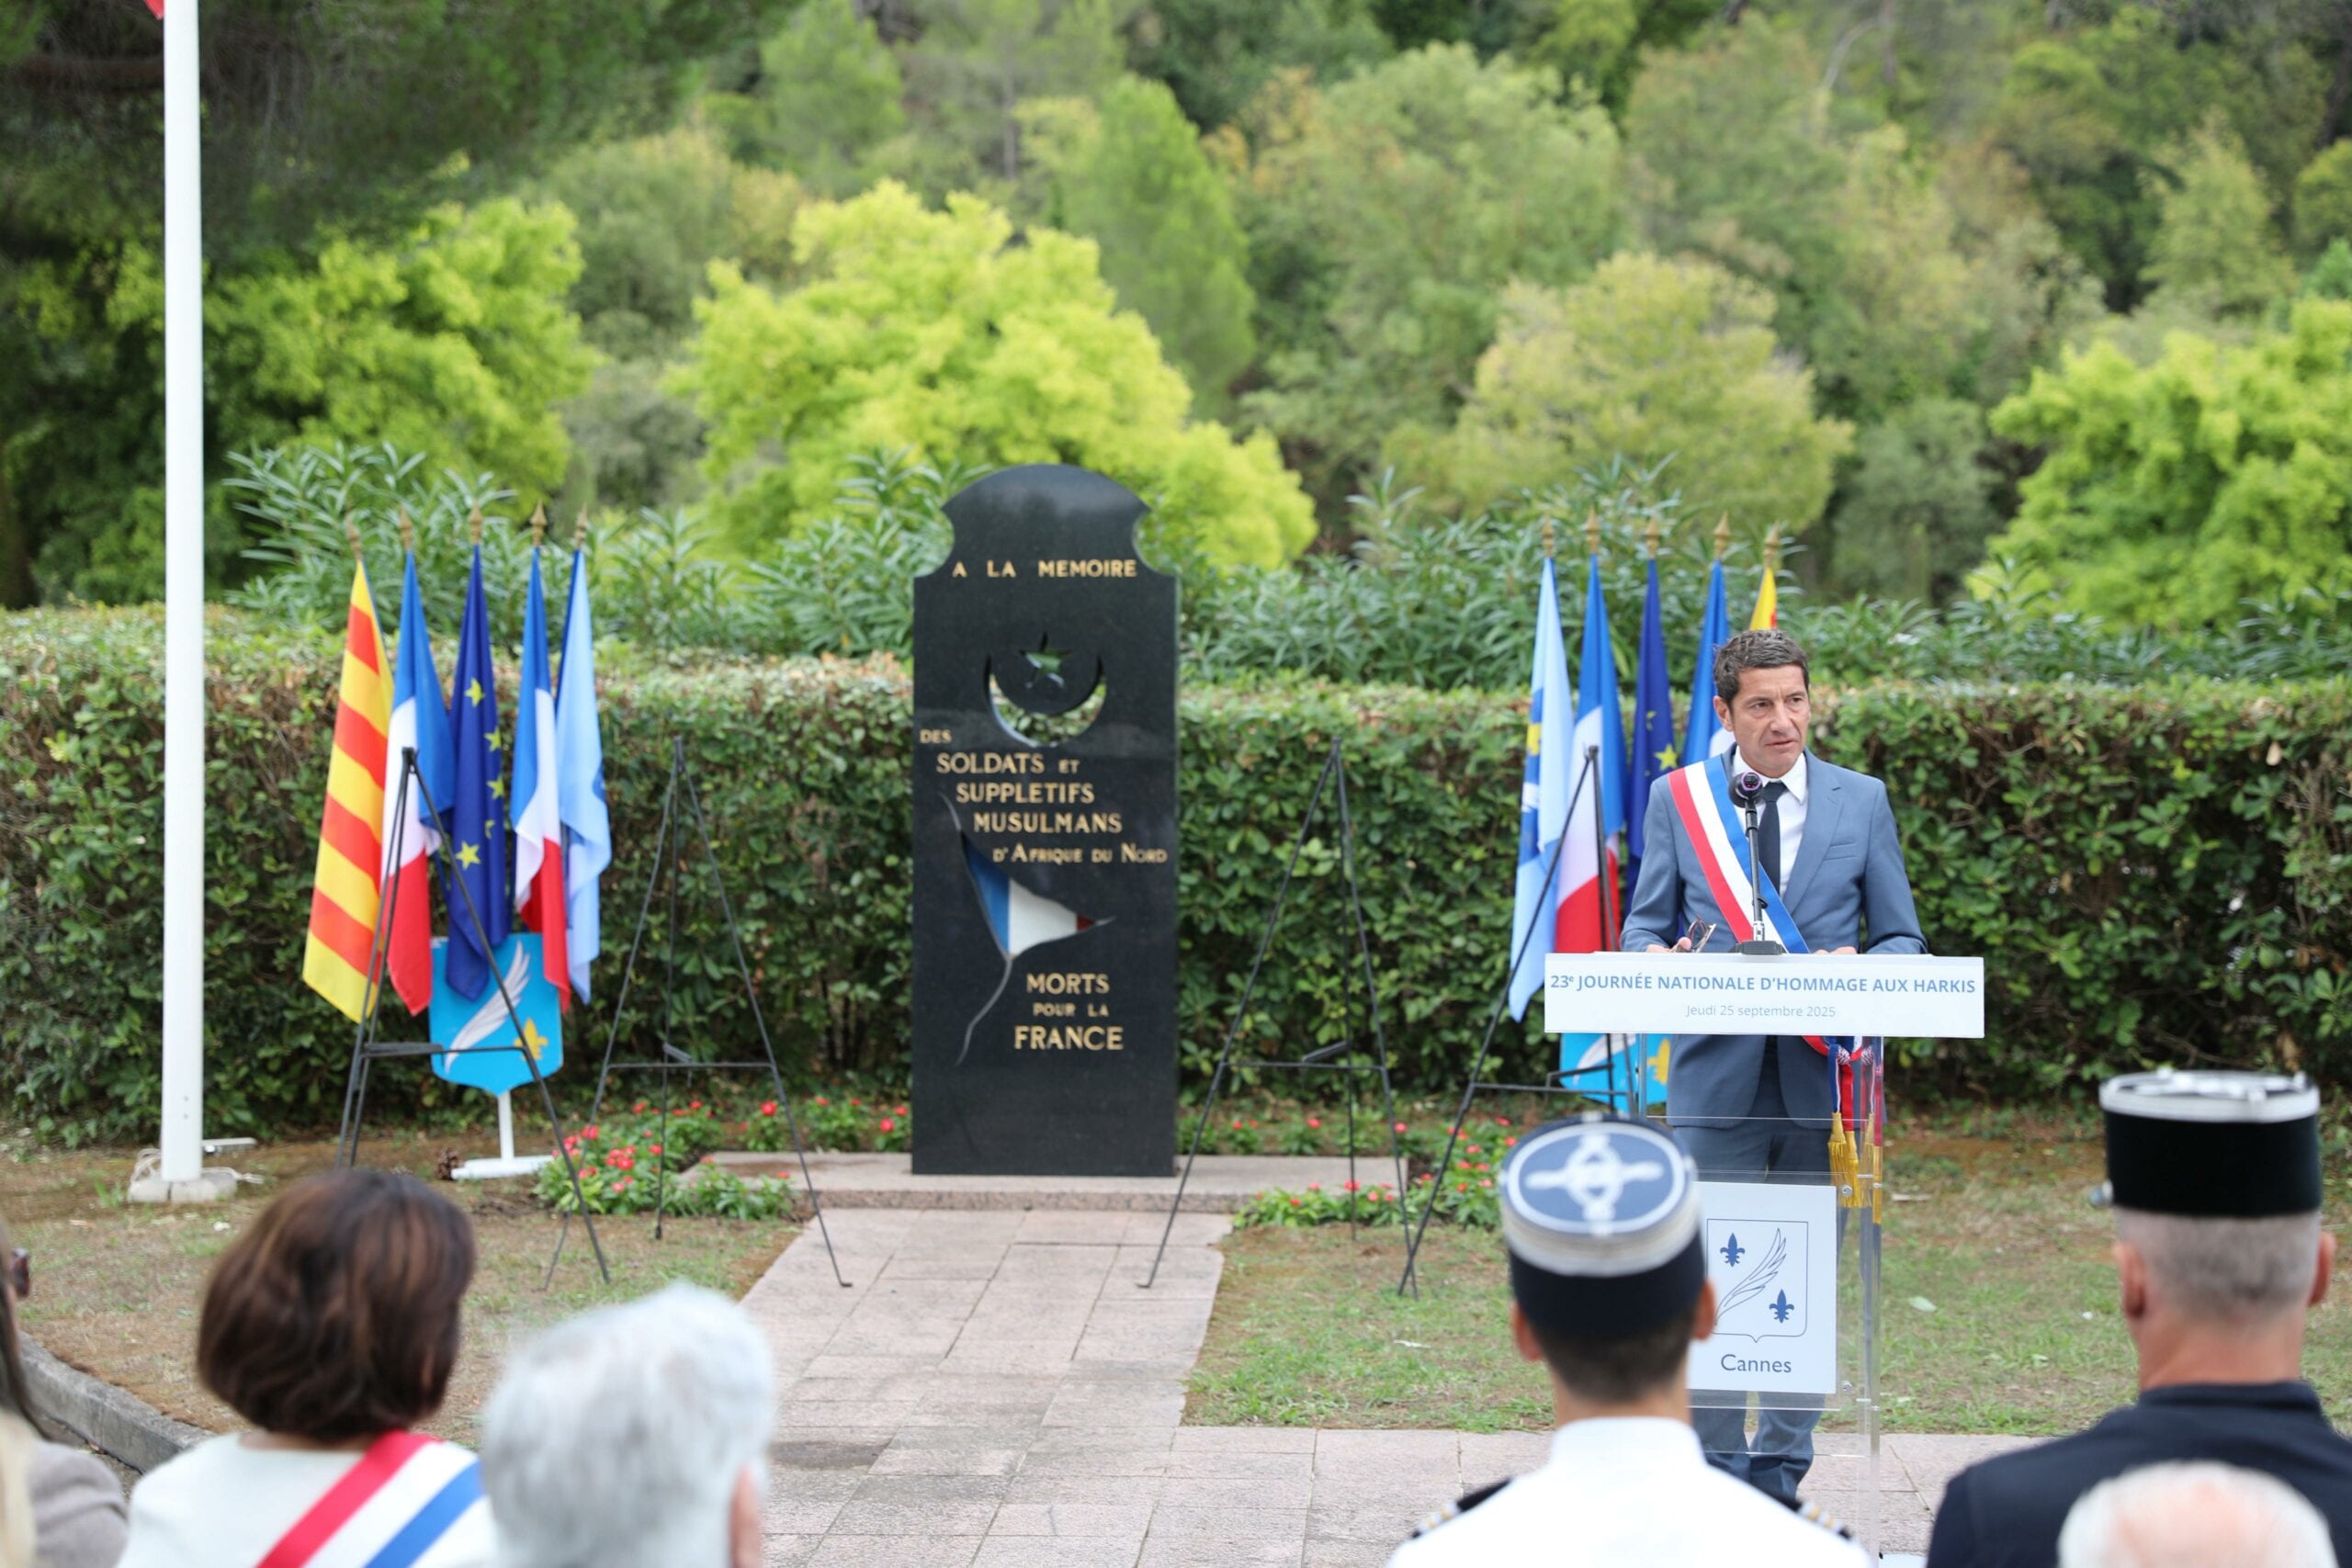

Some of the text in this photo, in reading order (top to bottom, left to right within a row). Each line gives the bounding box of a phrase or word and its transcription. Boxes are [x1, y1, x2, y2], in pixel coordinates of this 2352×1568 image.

[953, 558, 1137, 578] A LA MEMOIRE
[920, 728, 952, 743] DES
[936, 752, 1080, 773] SOLDATS ET
[956, 782, 1095, 804] SUPPLETIFS
[974, 812, 1123, 833] MUSULMANS
[1091, 849, 1113, 863] DU
[1026, 972, 1110, 995] MORTS
[1576, 972, 1653, 992] JOURNÉE
[1657, 976, 1755, 990] NATIONALE
[1871, 978, 1908, 993] AUX
[1913, 978, 1976, 994] HARKIS
[1033, 1002, 1109, 1017] POUR LA
[1685, 1005, 1837, 1020] Jeudi 25 septembre 2025
[1013, 1025, 1124, 1050] FRANCE
[1720, 1353, 1792, 1373] Cannes
